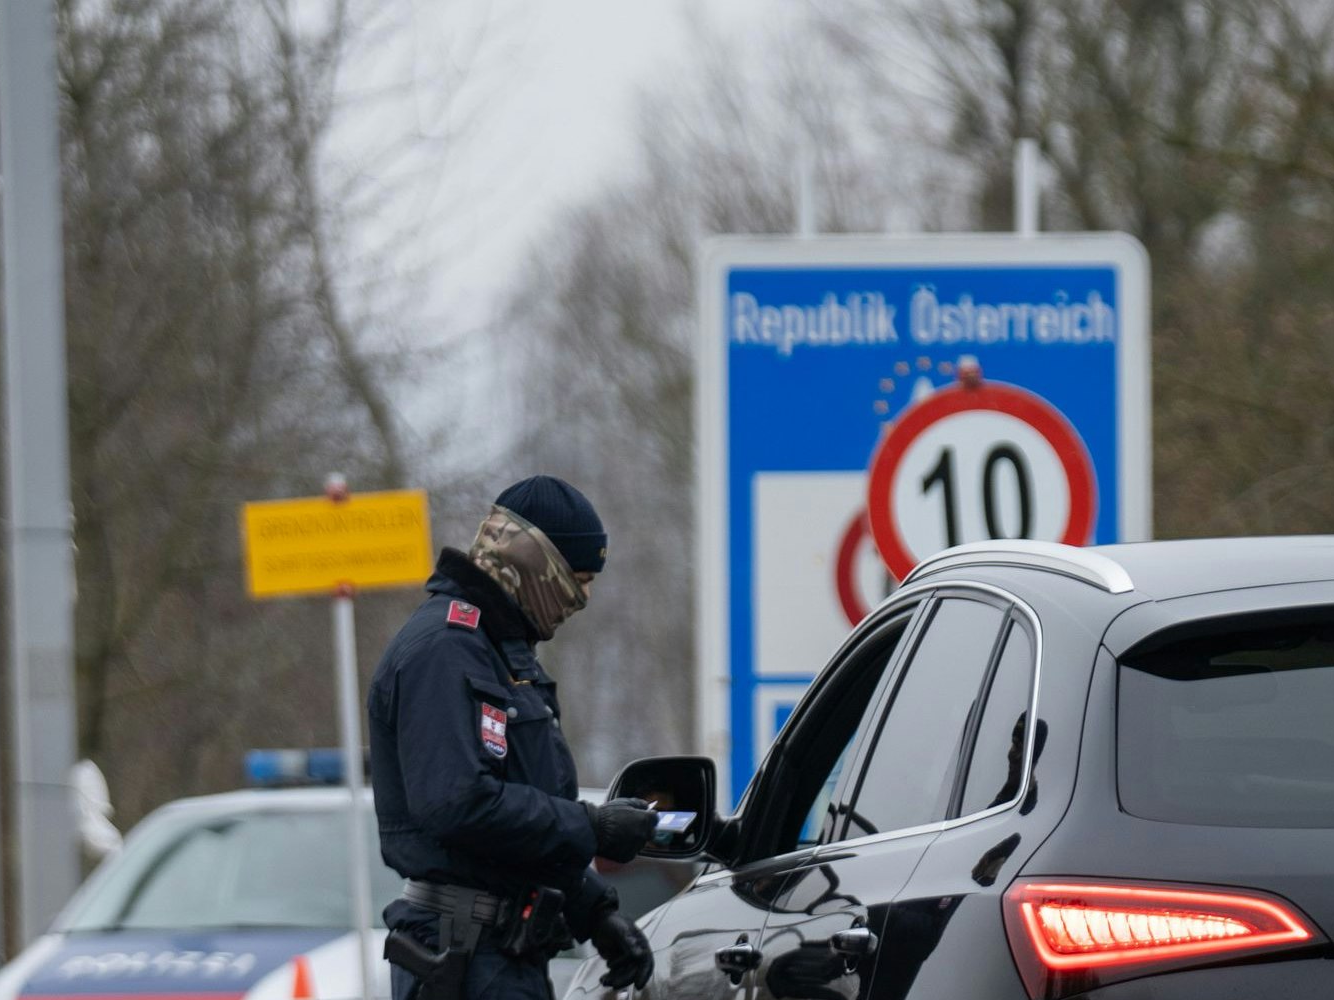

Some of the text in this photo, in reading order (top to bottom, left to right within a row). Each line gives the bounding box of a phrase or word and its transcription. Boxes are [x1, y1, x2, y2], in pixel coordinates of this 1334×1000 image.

[732, 284, 1116, 355] Republik Österreich
[922, 441, 1032, 546] 10
